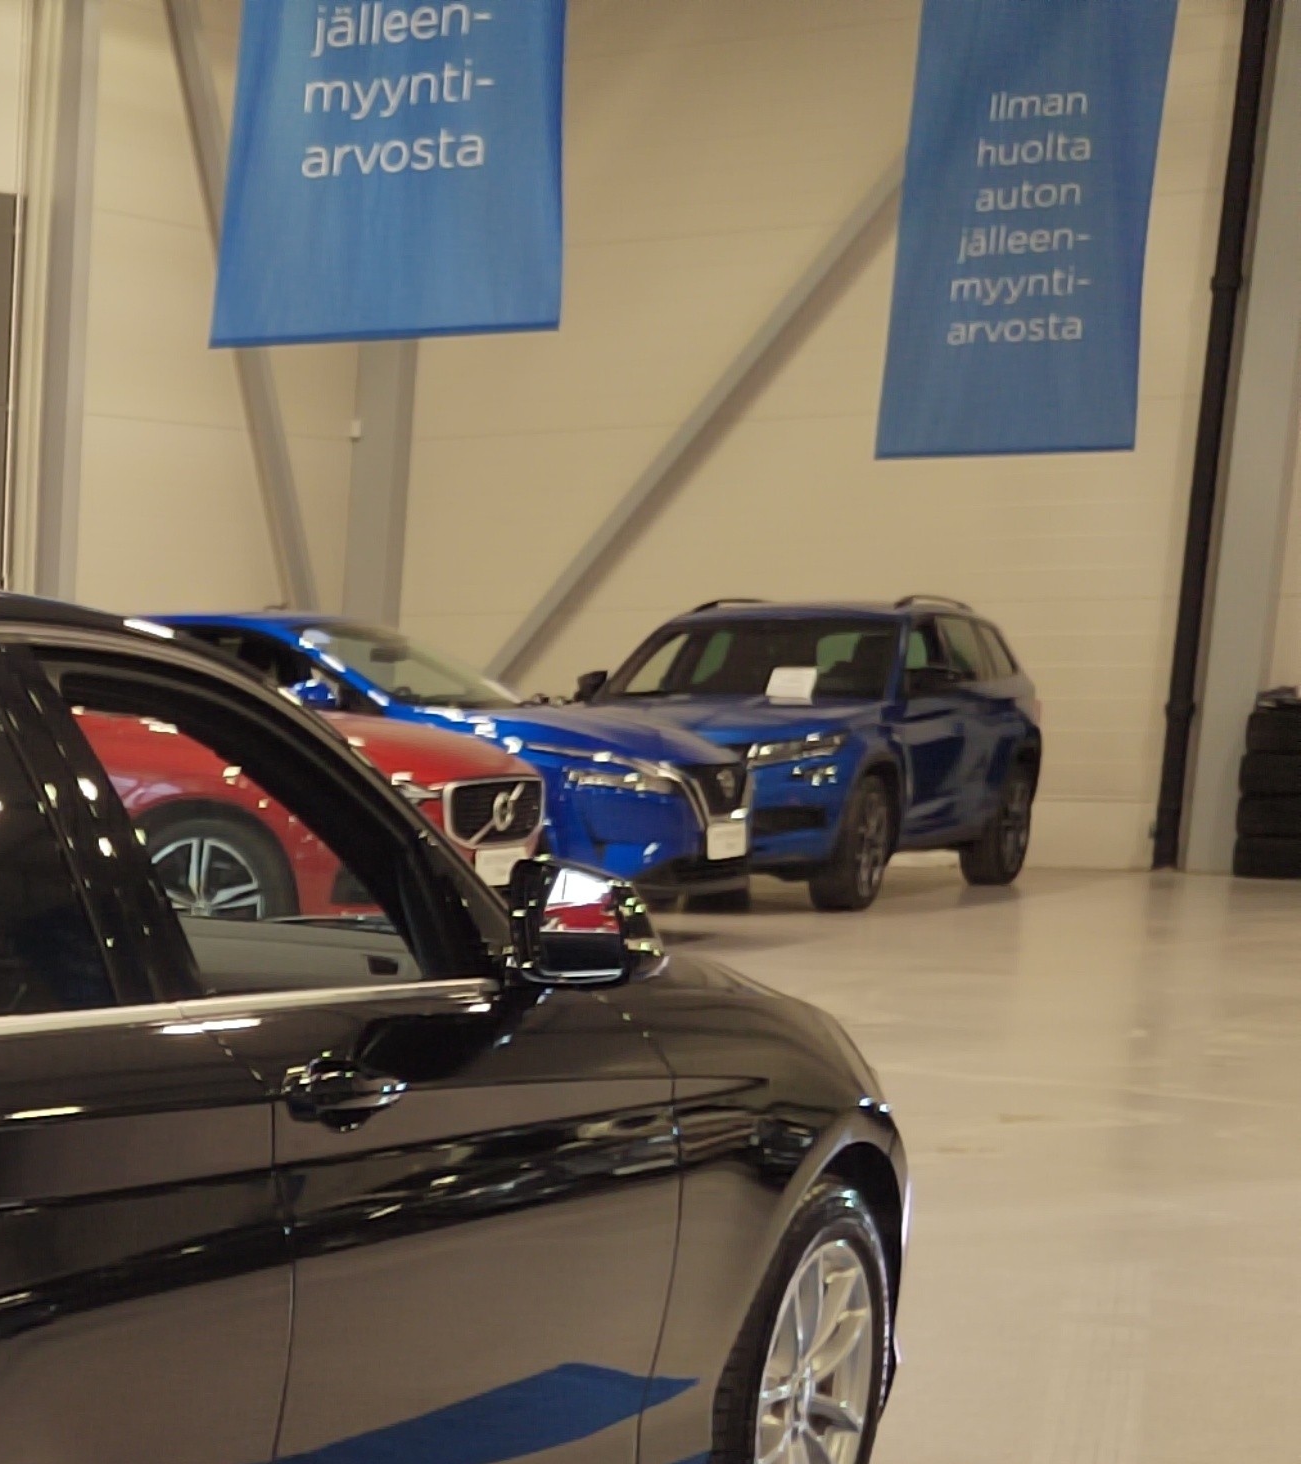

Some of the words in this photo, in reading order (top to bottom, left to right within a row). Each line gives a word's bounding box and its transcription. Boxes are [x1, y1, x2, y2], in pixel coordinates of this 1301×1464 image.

[311, 1, 492, 58] jälleen-
[304, 58, 495, 121] myynti-
[989, 91, 1089, 122] Ilman
[301, 128, 485, 178] arvosta
[976, 132, 1092, 167] huolta
[976, 180, 1082, 212] auton
[956, 225, 1092, 264] jälleen-
[950, 265, 1092, 306] myynti-
[946, 312, 1084, 346] arvosta
